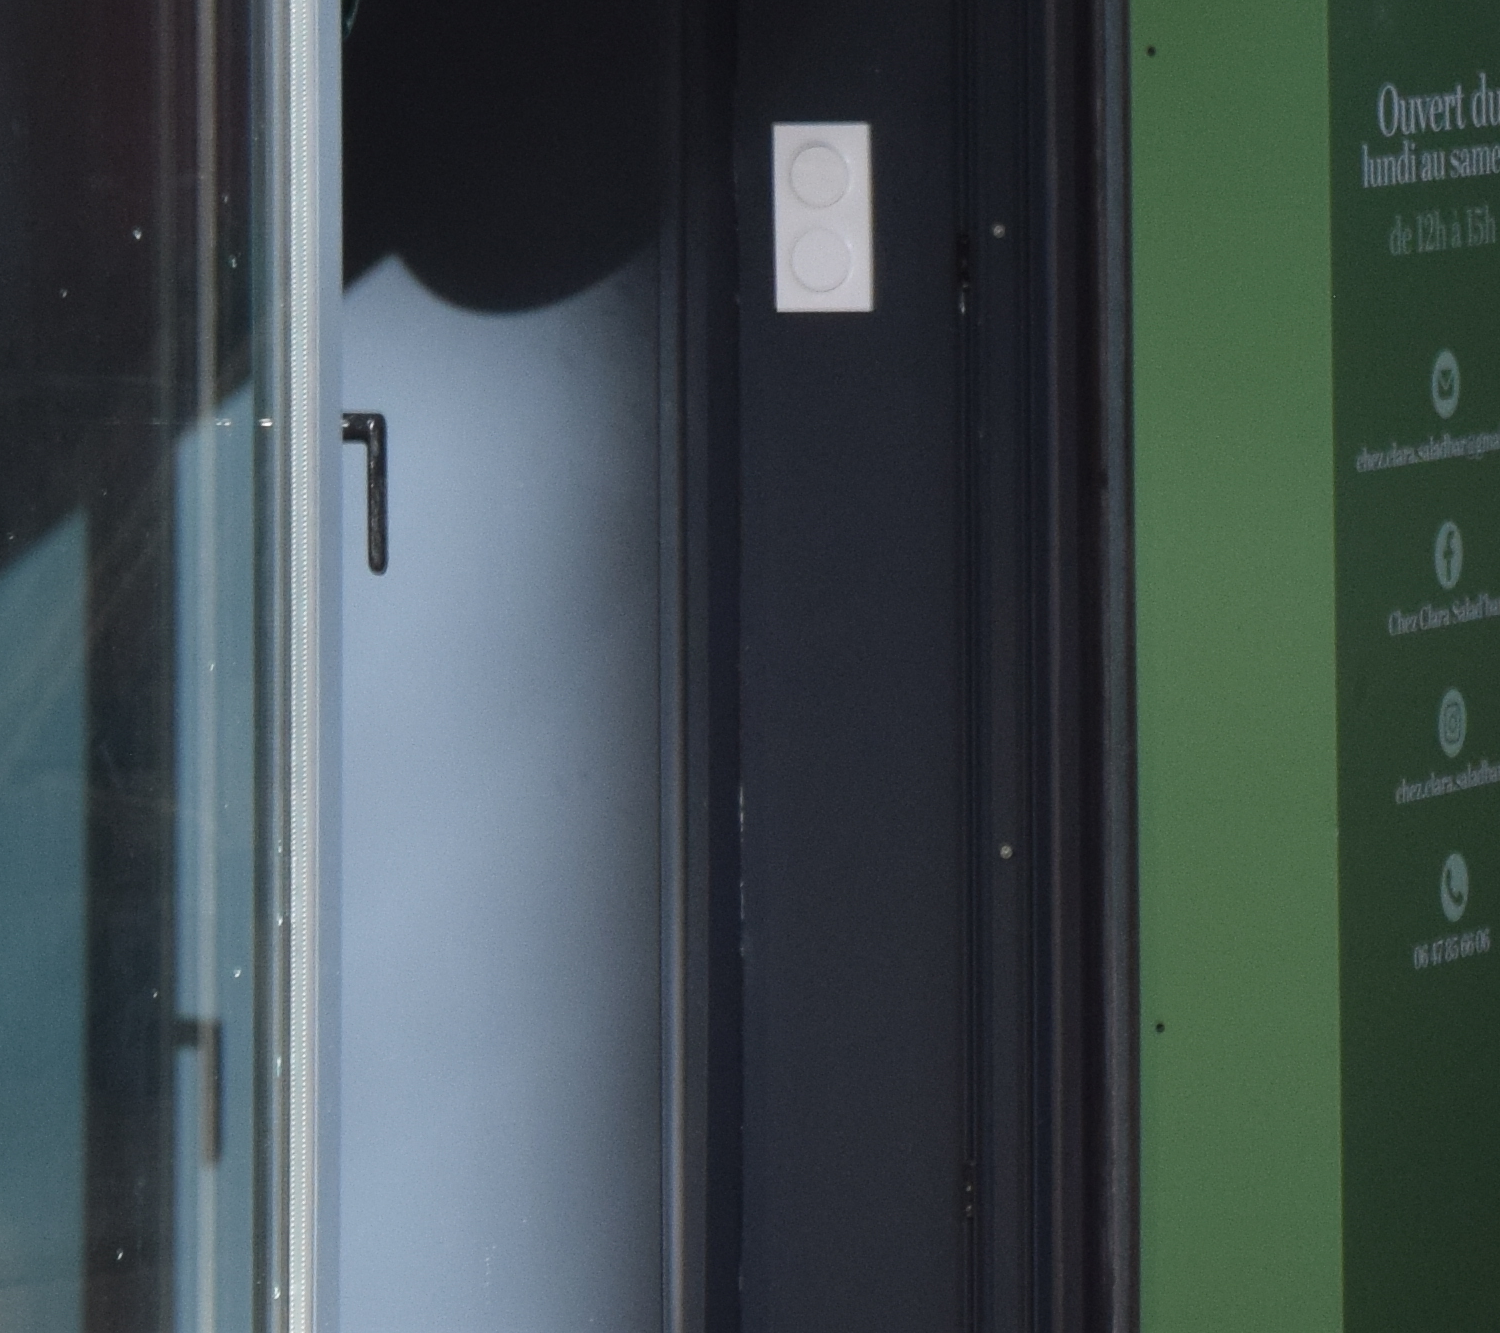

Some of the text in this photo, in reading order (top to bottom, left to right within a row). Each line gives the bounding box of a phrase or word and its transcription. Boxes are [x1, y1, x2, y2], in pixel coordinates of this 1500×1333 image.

[1377, 82, 1466, 137] Ouvert
[1361, 139, 1416, 189] lundi
[1421, 150, 1446, 181] au
[1389, 214, 1413, 256] de
[1416, 207, 1447, 254] 12h
